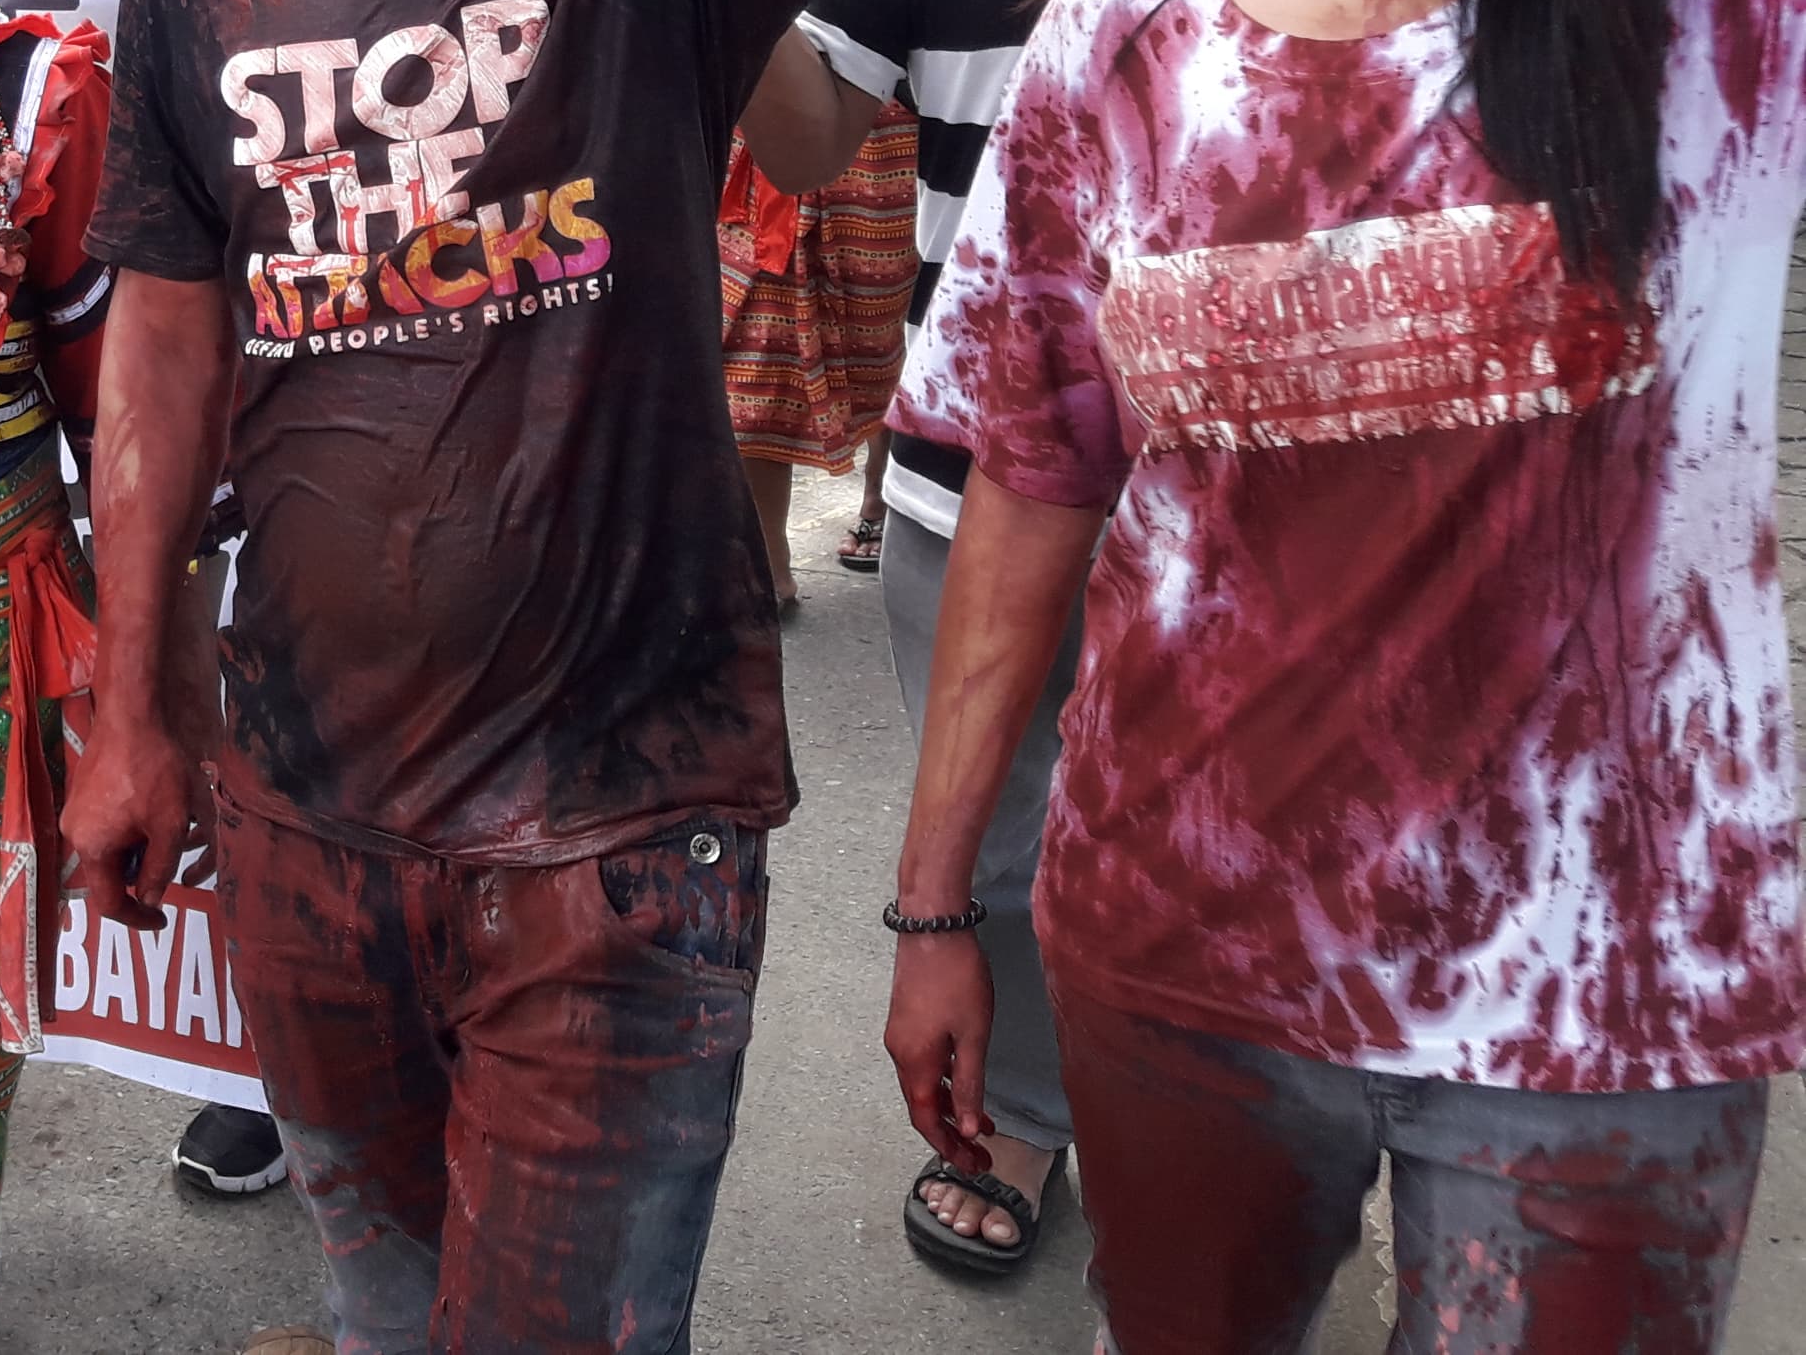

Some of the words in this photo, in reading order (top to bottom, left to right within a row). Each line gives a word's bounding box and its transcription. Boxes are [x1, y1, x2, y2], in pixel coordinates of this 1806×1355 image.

[254, 127, 486, 257] THE
[308, 311, 466, 356] PEOPLE'S
[482, 272, 615, 327] RIGHTS!
